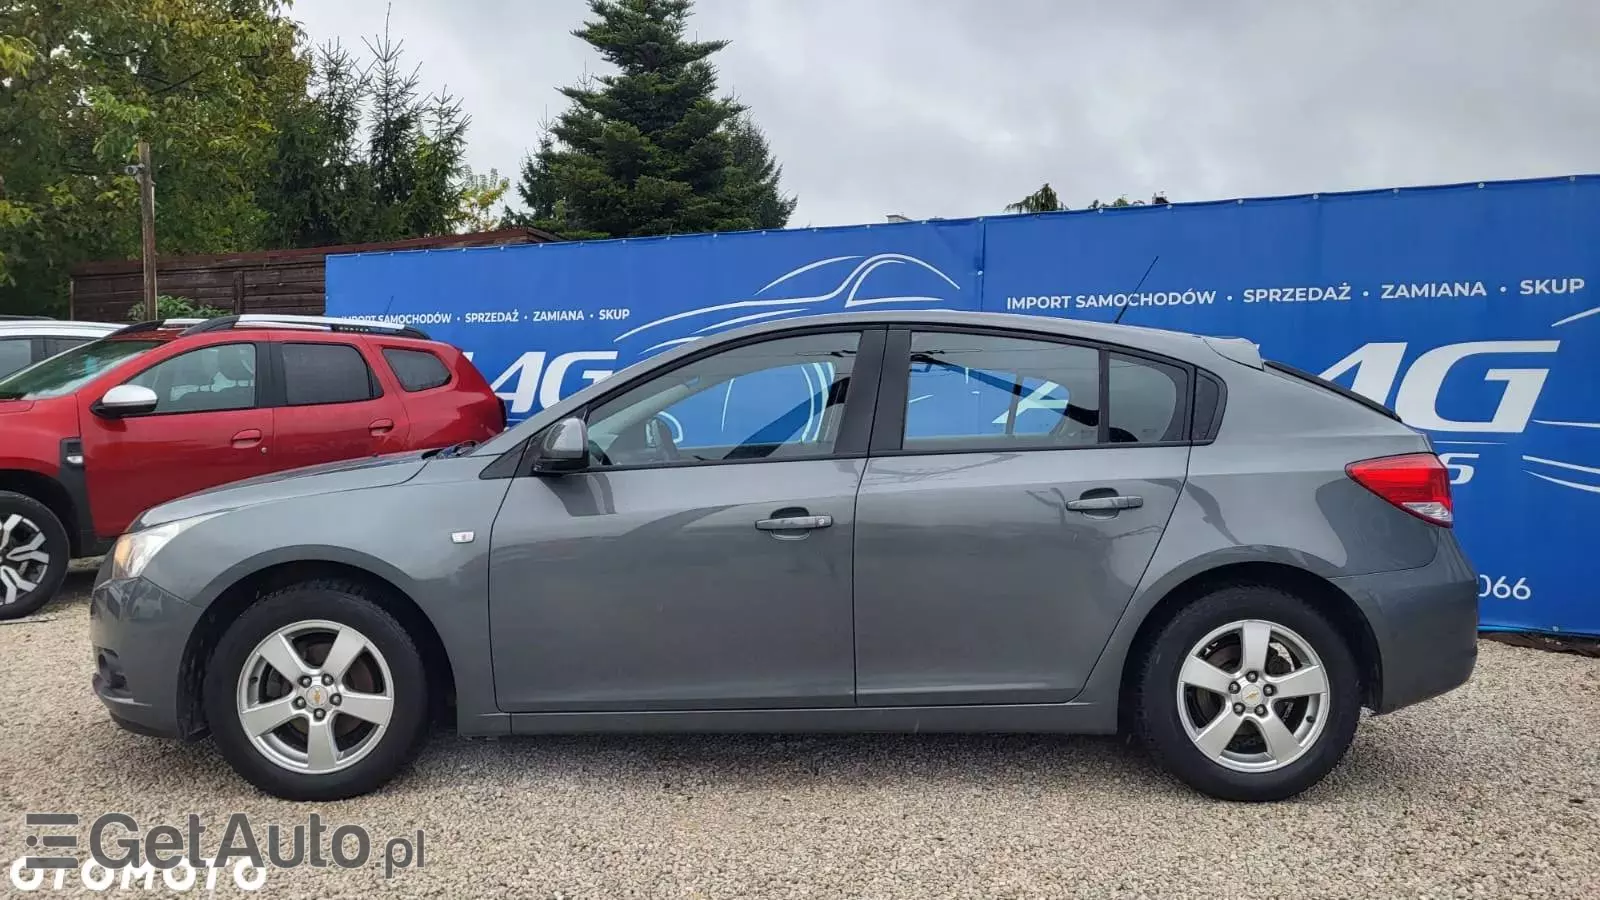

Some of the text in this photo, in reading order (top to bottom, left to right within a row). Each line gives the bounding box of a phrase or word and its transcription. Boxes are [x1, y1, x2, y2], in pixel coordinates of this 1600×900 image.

[1006, 278, 1585, 310] IMPORT SAMOCHODÓW SPRZEDAŻ ZAMIANA SKUP
[465, 309, 519, 323] SPRZEDAŻ
[533, 310, 585, 322] ZAMIANA
[599, 309, 630, 320] SKUP
